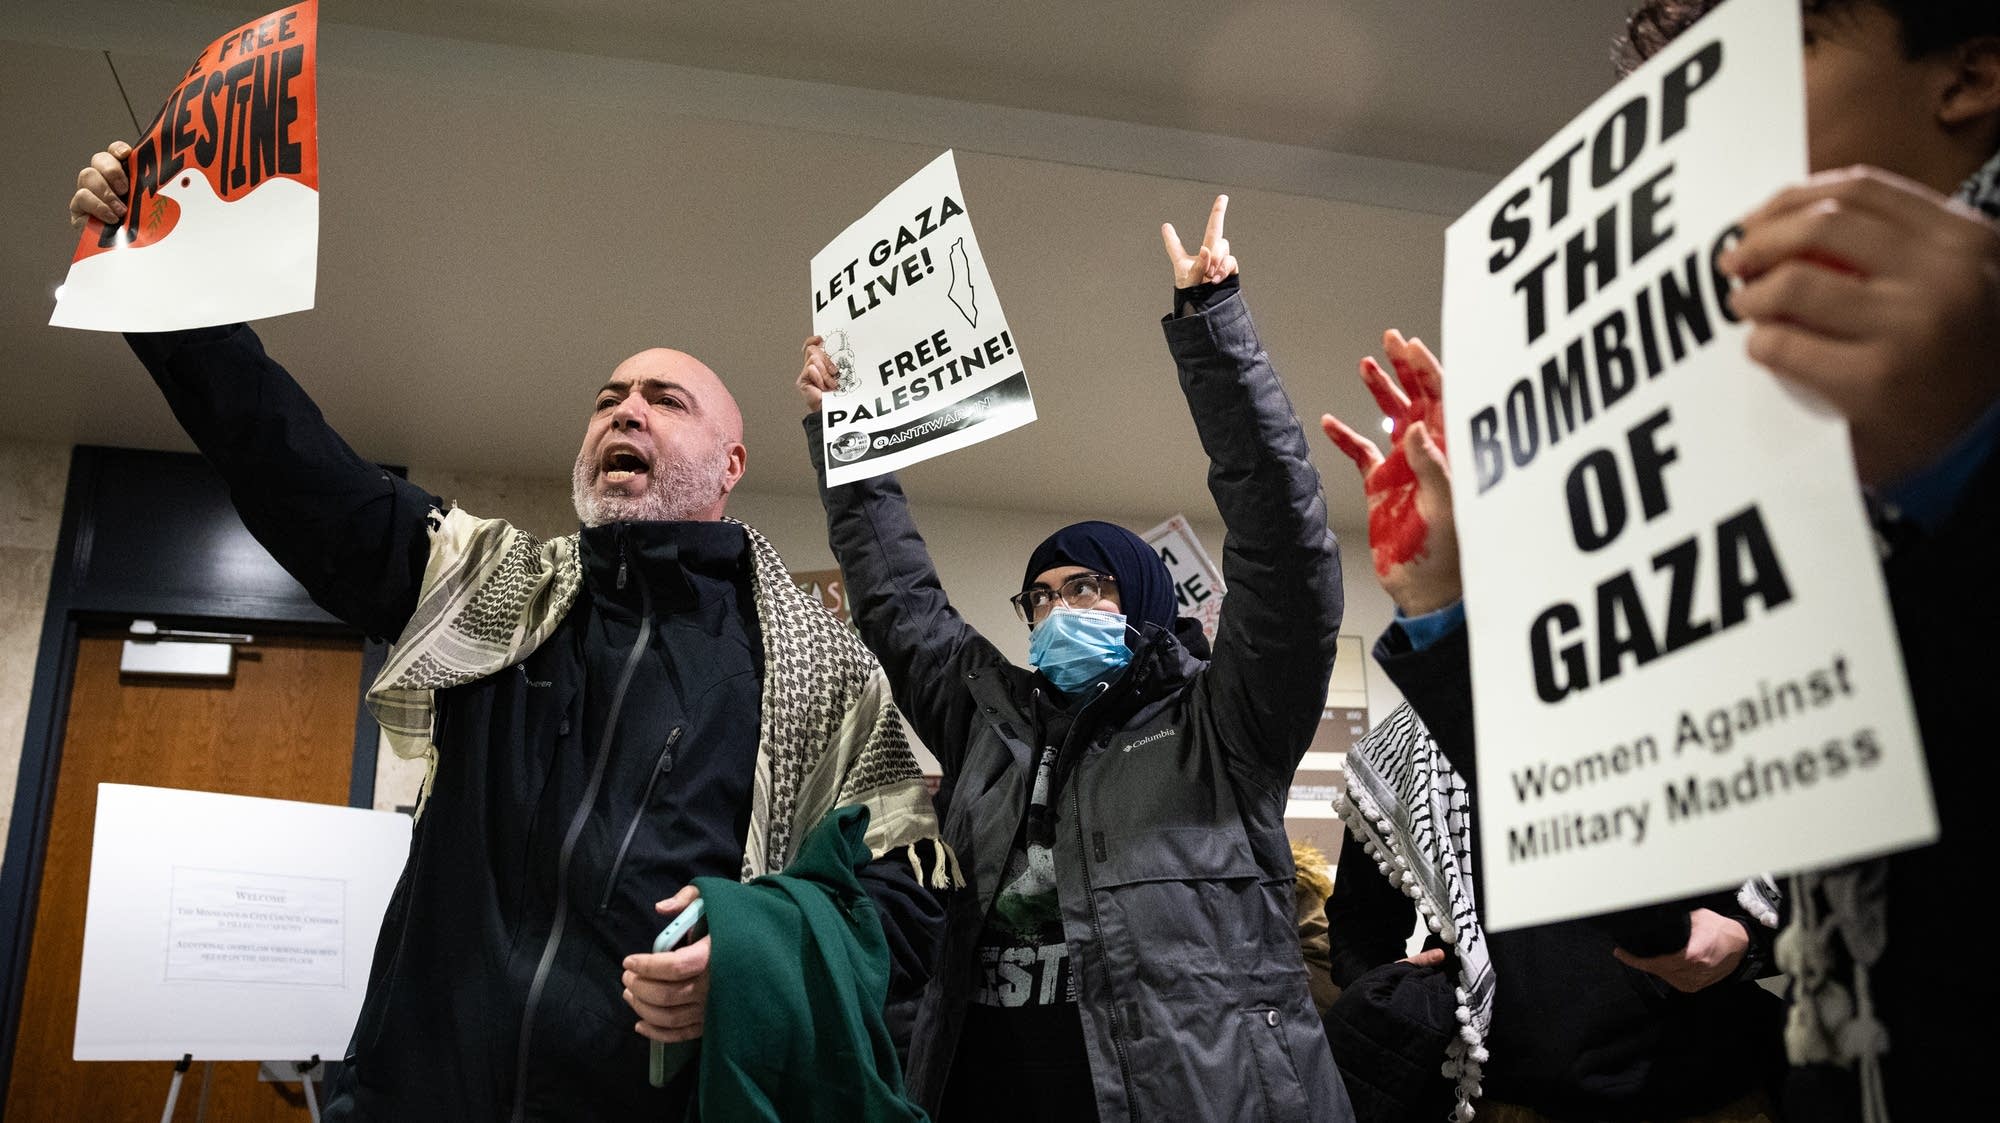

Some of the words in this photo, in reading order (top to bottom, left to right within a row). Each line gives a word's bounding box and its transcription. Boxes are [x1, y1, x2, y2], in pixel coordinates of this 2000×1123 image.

[219, 11, 297, 62] FREE
[1489, 40, 1723, 275] STOP
[815, 259, 859, 313] LET
[868, 196, 964, 268] GAZA
[846, 247, 934, 320] LIVE!
[1513, 162, 1675, 346] THE
[827, 331, 1014, 428] PALESTINE!
[878, 329, 952, 387] FREE
[1564, 406, 1683, 553] OF
[1529, 504, 1795, 705] GAZA
[1133, 728, 1175, 748] Columbia
[1511, 735, 1659, 804] Women
[1673, 654, 1855, 754] Against
[1506, 799, 1652, 865] Military
[1664, 726, 1884, 826] Madness
